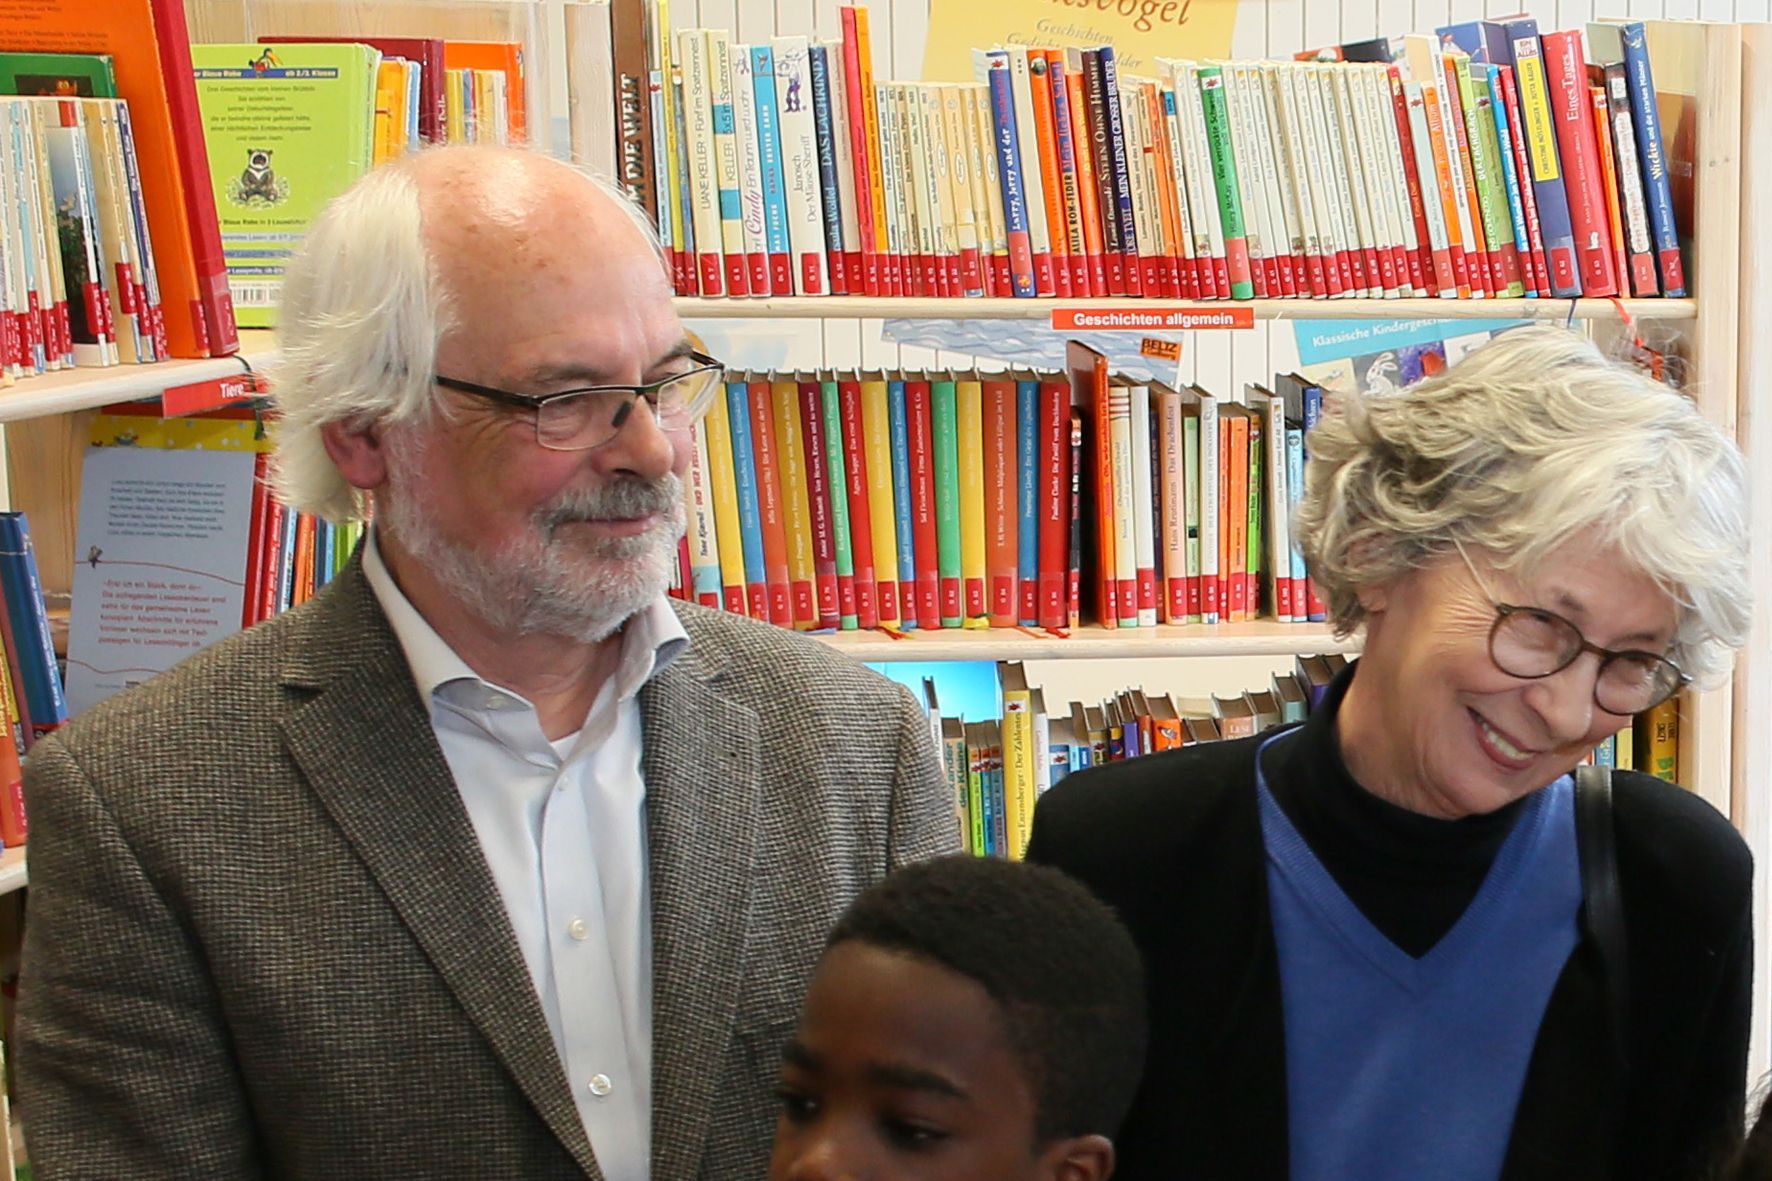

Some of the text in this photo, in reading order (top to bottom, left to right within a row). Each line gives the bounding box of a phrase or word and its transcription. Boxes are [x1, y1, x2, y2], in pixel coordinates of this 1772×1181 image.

[312, 69, 337, 77] Klasse
[689, 38, 702, 95] Spatzennest
[717, 40, 729, 99] Spatzennest
[1088, 59, 1101, 104] HIMMEL
[1104, 60, 1117, 97] BRUDER
[1635, 60, 1648, 86] Männer
[621, 73, 642, 137] WELT
[812, 59, 830, 136] LACHKIND
[1560, 55, 1580, 121] Eines Tages
[1093, 108, 1106, 142] OHNE
[1109, 98, 1122, 133] GROSSER
[1644, 115, 1653, 125] die
[1645, 126, 1656, 140] und
[623, 140, 643, 180] DIE
[693, 141, 709, 178] KELLER
[800, 135, 813, 169] Sheriff
[819, 139, 833, 166] DAS
[1114, 135, 1128, 173] KLEINER
[1210, 126, 1223, 160] verrückte
[1647, 141, 1662, 179] Wickie
[723, 143, 735, 181] KELLER
[1001, 128, 1022, 230] Larry, Jerry und der
[1099, 146, 1110, 181] STERN
[1215, 163, 1225, 180] Vier
[697, 179, 712, 209] LIANE
[1118, 175, 1131, 198] MEIN
[743, 190, 763, 234] Cindy
[807, 204, 817, 222] Der
[1223, 185, 1237, 233] Hilary McKay
[1070, 227, 1081, 253] ALILA
[1074, 311, 1233, 328] Geschichten allgemein
[1141, 337, 1178, 352] BELTZ
[1312, 328, 1370, 347] Klassische
[219, 382, 245, 399] Tiere
[1051, 463, 1060, 473] Die
[1167, 405, 1179, 551] Hans Reutimann Das Drachenfest
[956, 742, 965, 784] Kleine
[1015, 753, 1024, 768] Der
[1016, 774, 1026, 828] Enzensberger
